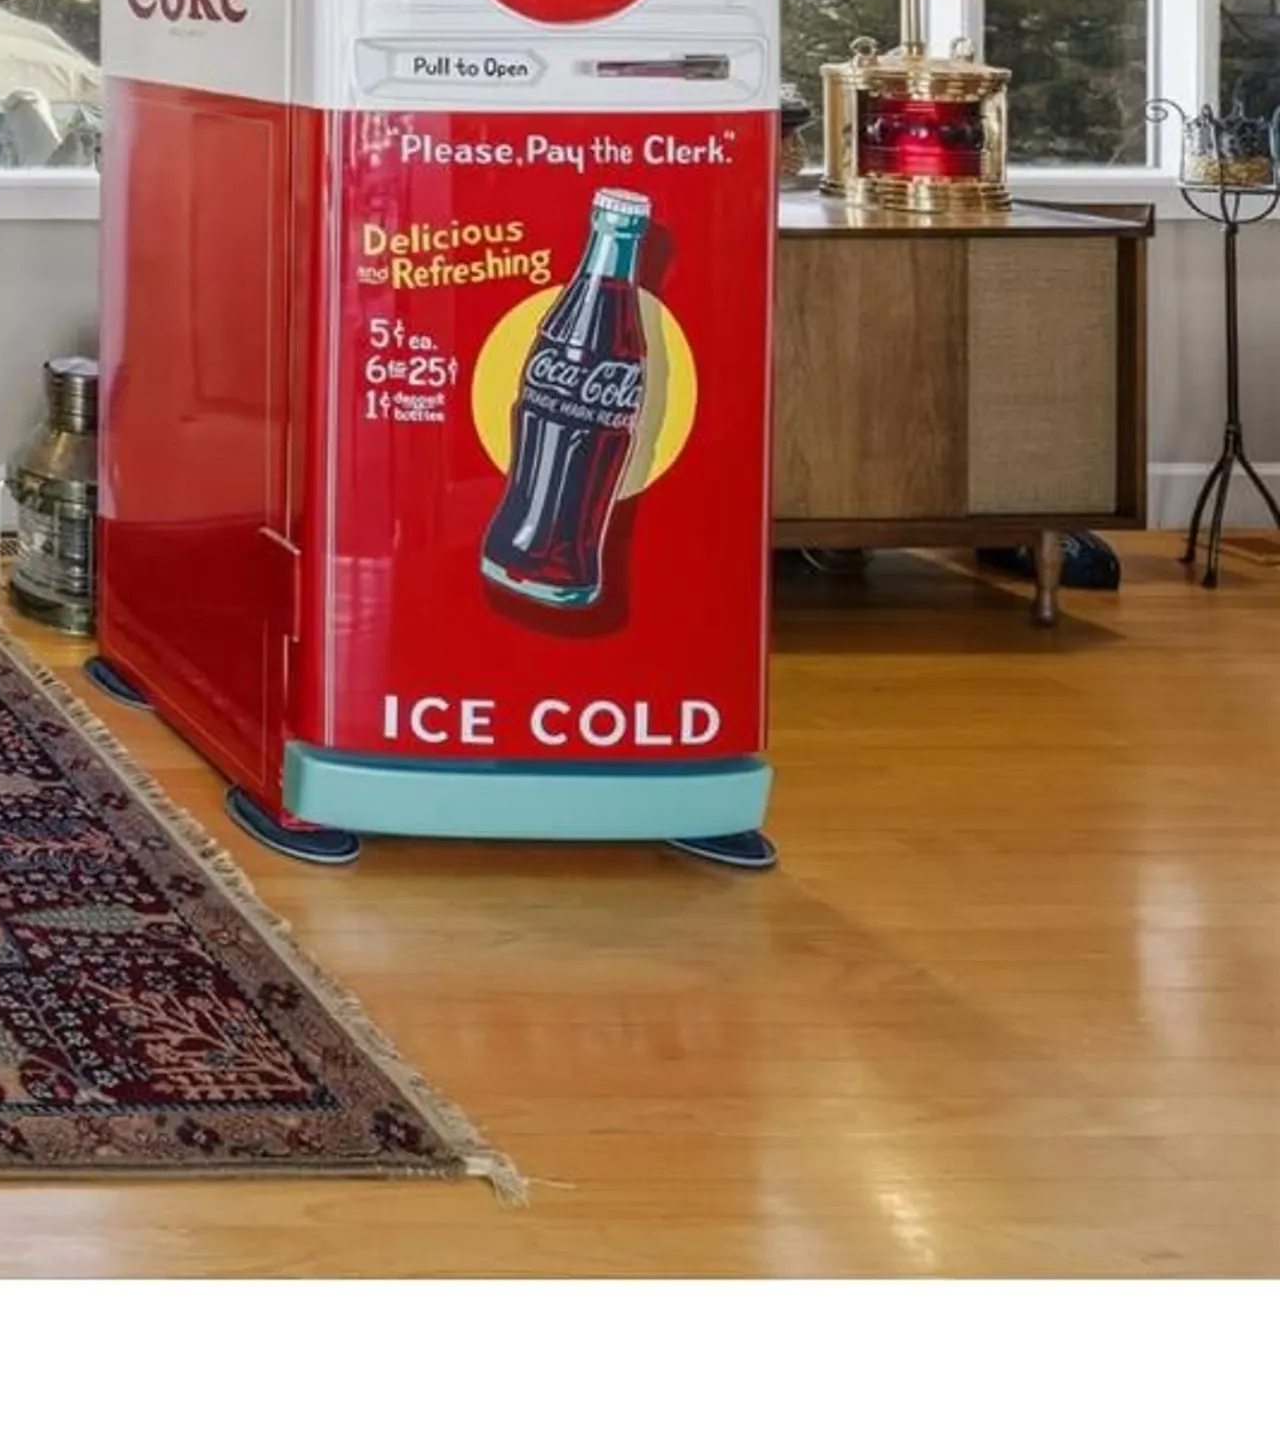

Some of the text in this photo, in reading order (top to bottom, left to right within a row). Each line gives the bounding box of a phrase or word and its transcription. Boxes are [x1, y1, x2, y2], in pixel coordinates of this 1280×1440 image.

[413, 57, 528, 78] Pull to Open
[526, 134, 585, 174] Pay
[590, 136, 633, 164] the
[363, 220, 524, 256] Delicious
[356, 248, 552, 289] and Refreshing
[383, 695, 721, 747] ICE COLD
